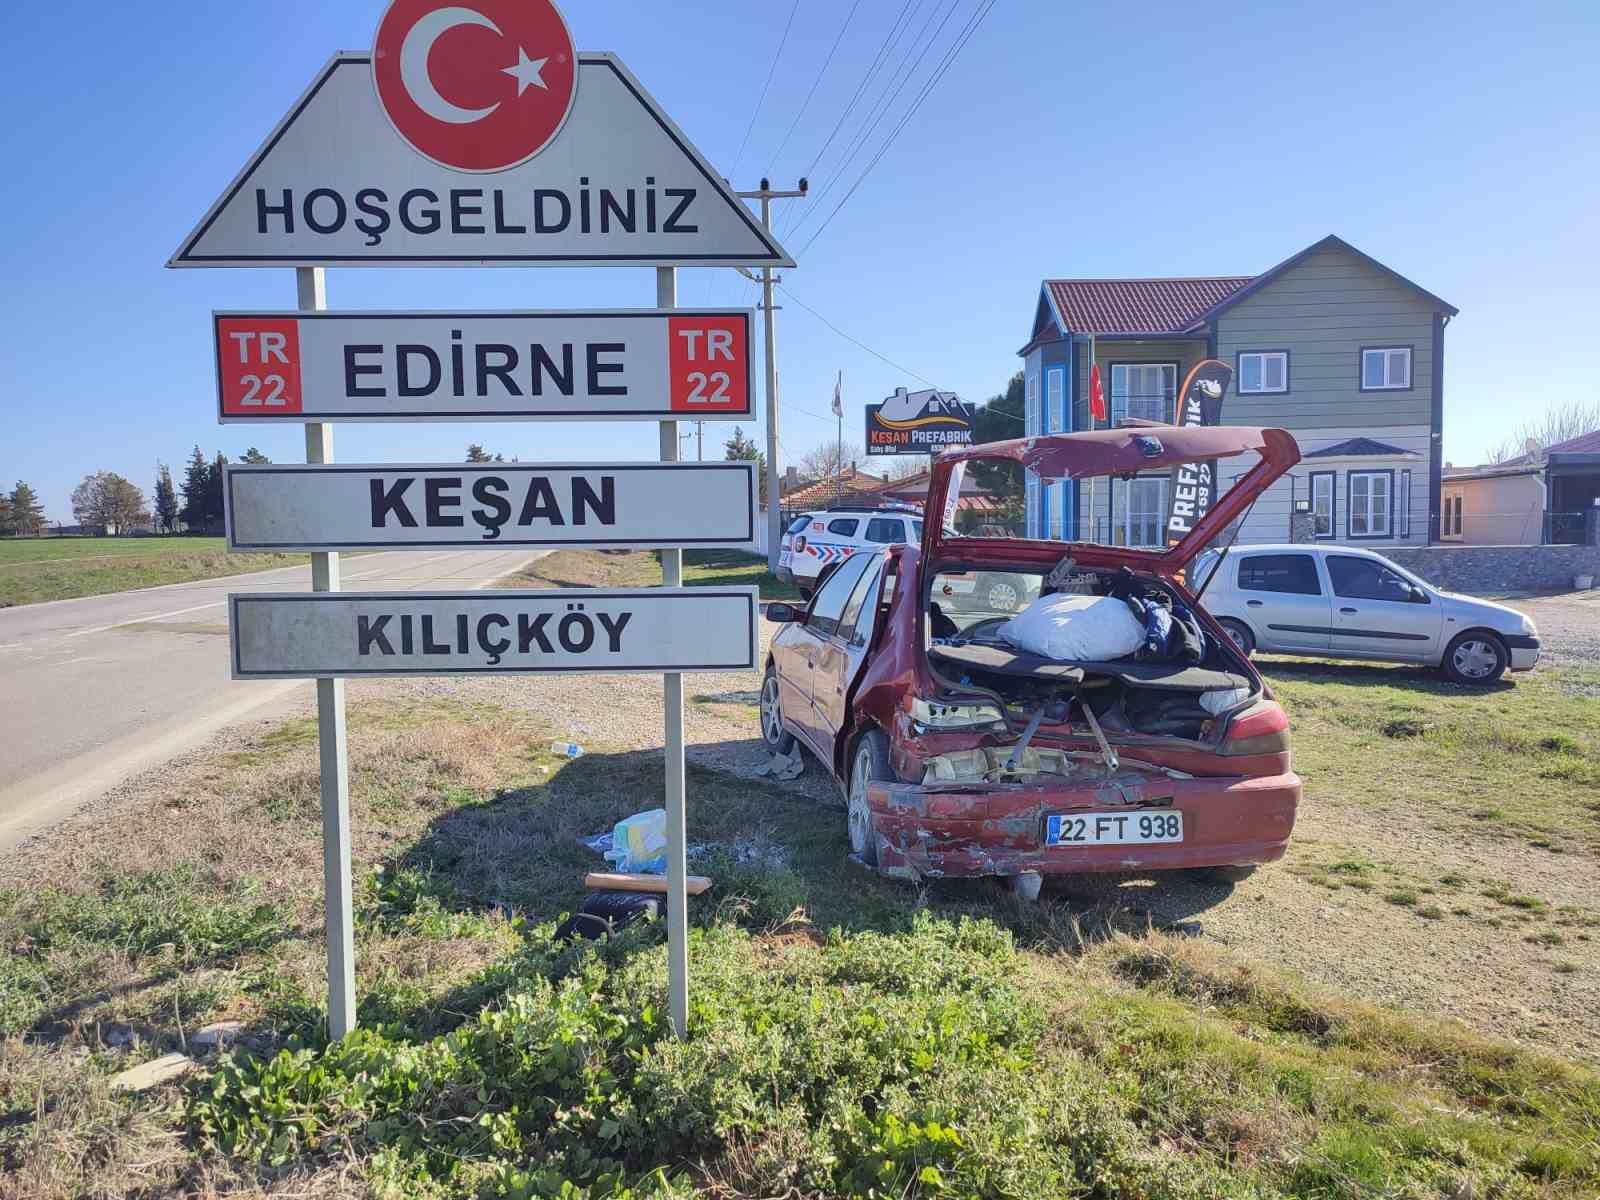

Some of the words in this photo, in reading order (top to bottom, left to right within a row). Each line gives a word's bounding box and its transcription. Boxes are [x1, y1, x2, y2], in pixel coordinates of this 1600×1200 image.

[255, 176, 699, 247] HOŞGELDİNİZ
[229, 331, 290, 364] TR
[678, 330, 736, 361] TR
[343, 329, 628, 398] EDİRNE
[240, 374, 287, 406] 22
[686, 371, 732, 403] 22
[369, 476, 616, 540] KEŞAN
[356, 603, 633, 666] KILIÇKÖY
[1059, 818, 1087, 842] 22
[1095, 816, 1129, 841] FT
[1139, 814, 1179, 839] 938
